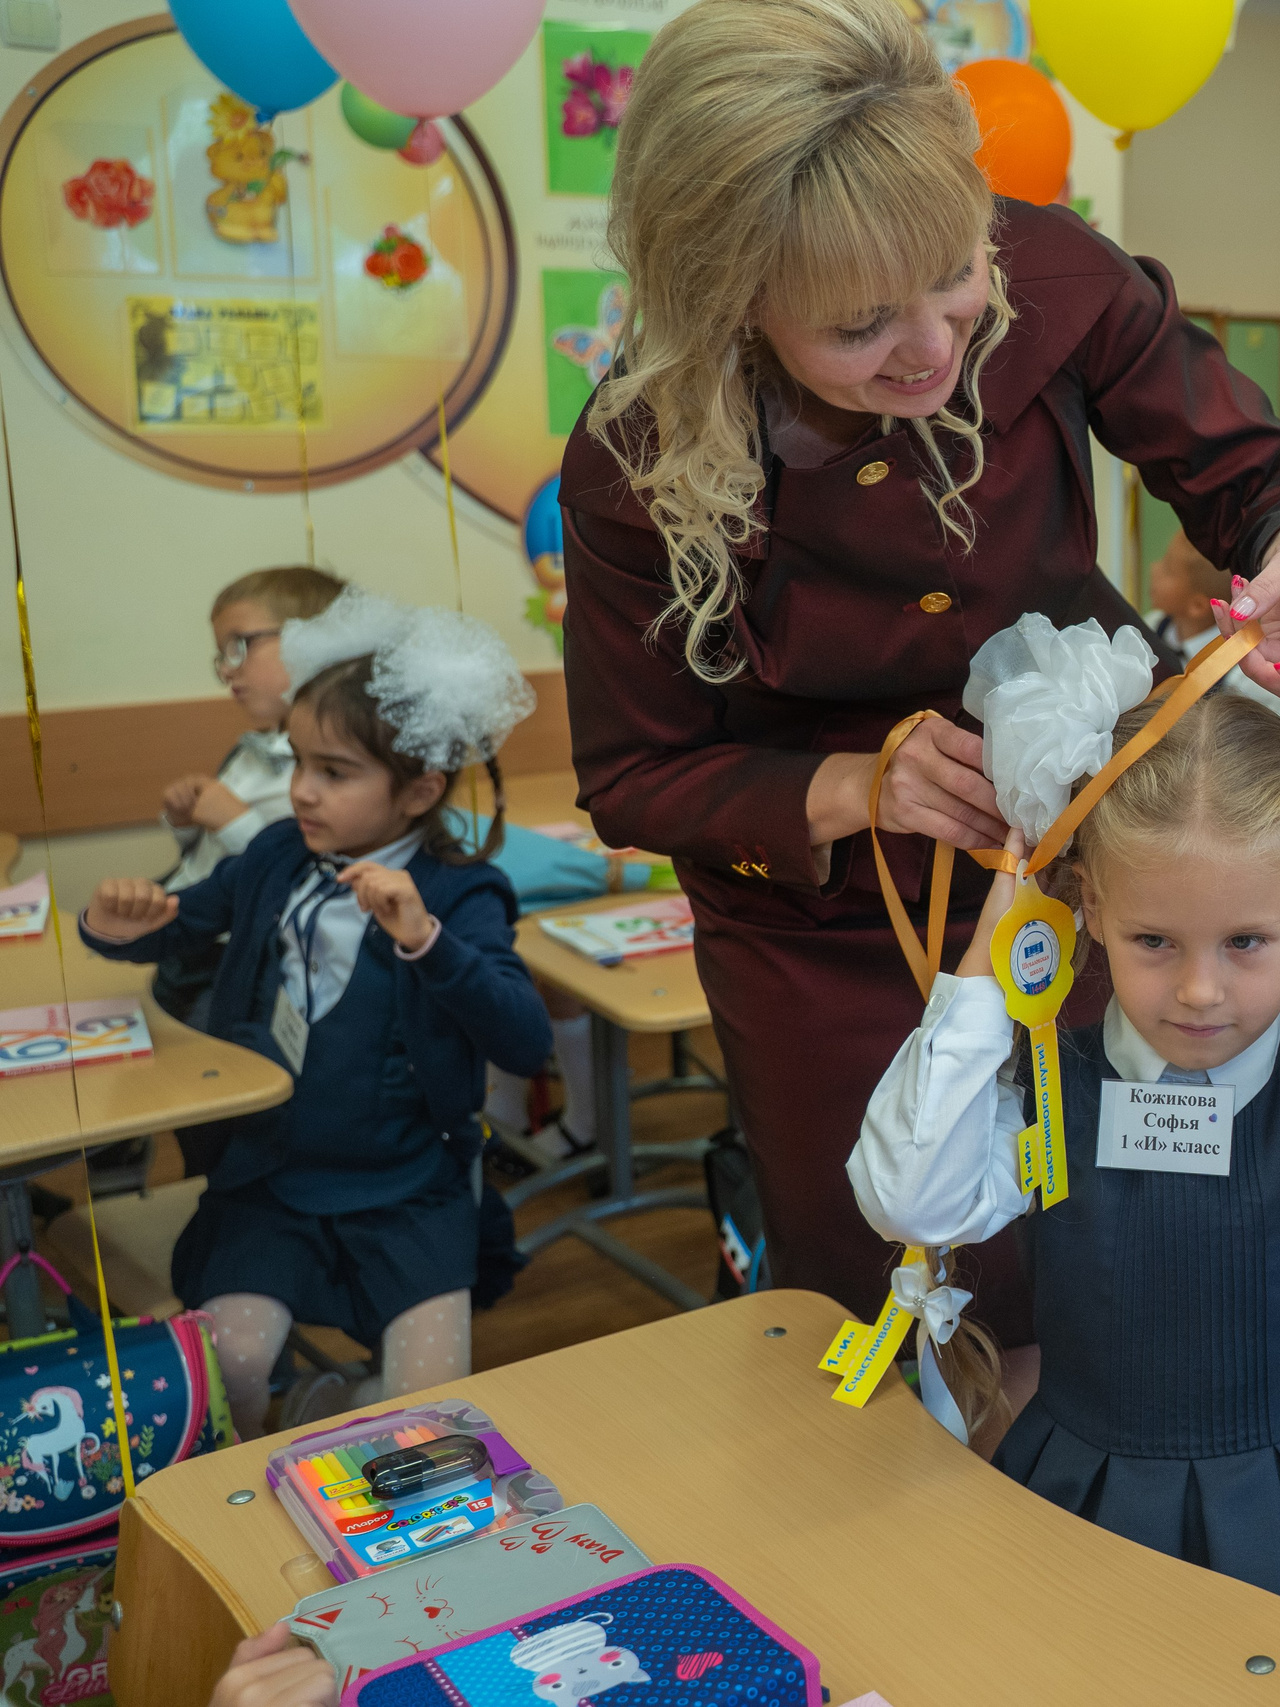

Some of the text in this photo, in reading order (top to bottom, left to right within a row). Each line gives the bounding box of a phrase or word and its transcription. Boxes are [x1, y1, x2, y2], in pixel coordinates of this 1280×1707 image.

[1129, 1087, 1217, 1108] Кожикова
[1035, 1042, 1055, 1195] Счастливого пути!
[1143, 1112, 1200, 1132] Софья
[1121, 1134, 1220, 1155] 1 «И» класс
[1024, 1175, 1034, 1187] 1
[844, 1307, 899, 1393] Счастливого
[826, 1358, 839, 1367] 1
[471, 1499, 488, 1511] 15
[346, 1513, 390, 1532] Maped
[563, 1533, 625, 1564] Diary
